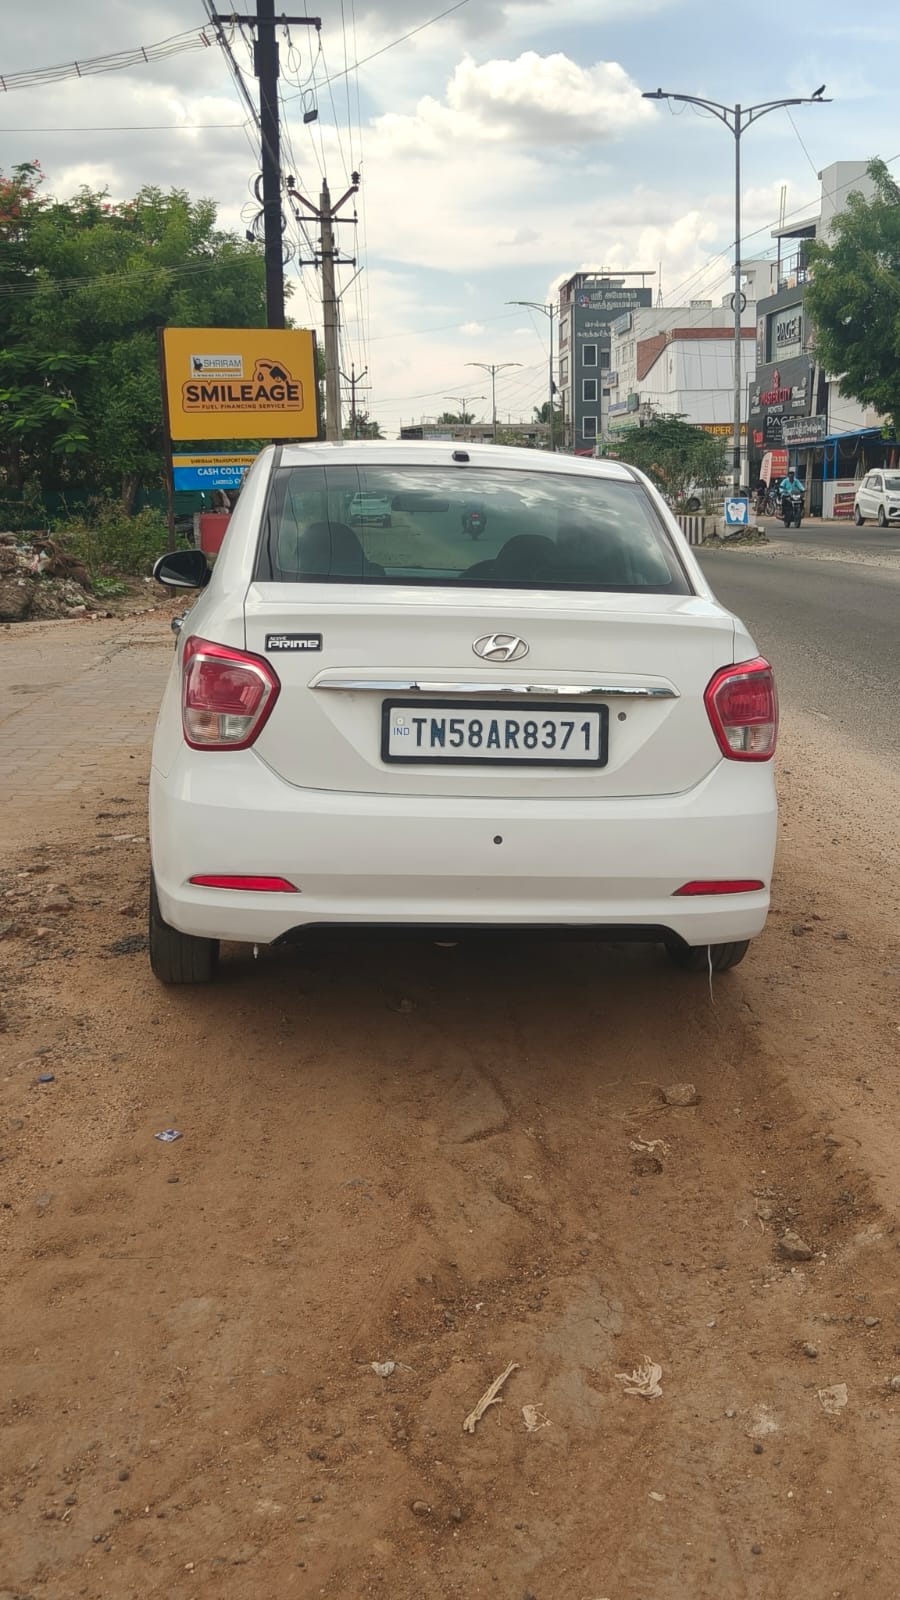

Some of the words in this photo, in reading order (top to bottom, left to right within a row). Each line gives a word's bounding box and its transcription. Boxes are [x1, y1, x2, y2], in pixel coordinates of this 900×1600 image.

[203, 359, 242, 368] SHRIRAM
[186, 385, 299, 402] SMILEAGE
[704, 425, 732, 435] SUPER
[197, 467, 218, 476] CASH
[268, 640, 319, 648] PRIME
[393, 727, 410, 736] IND
[412, 717, 591, 751] TN58AR8371
